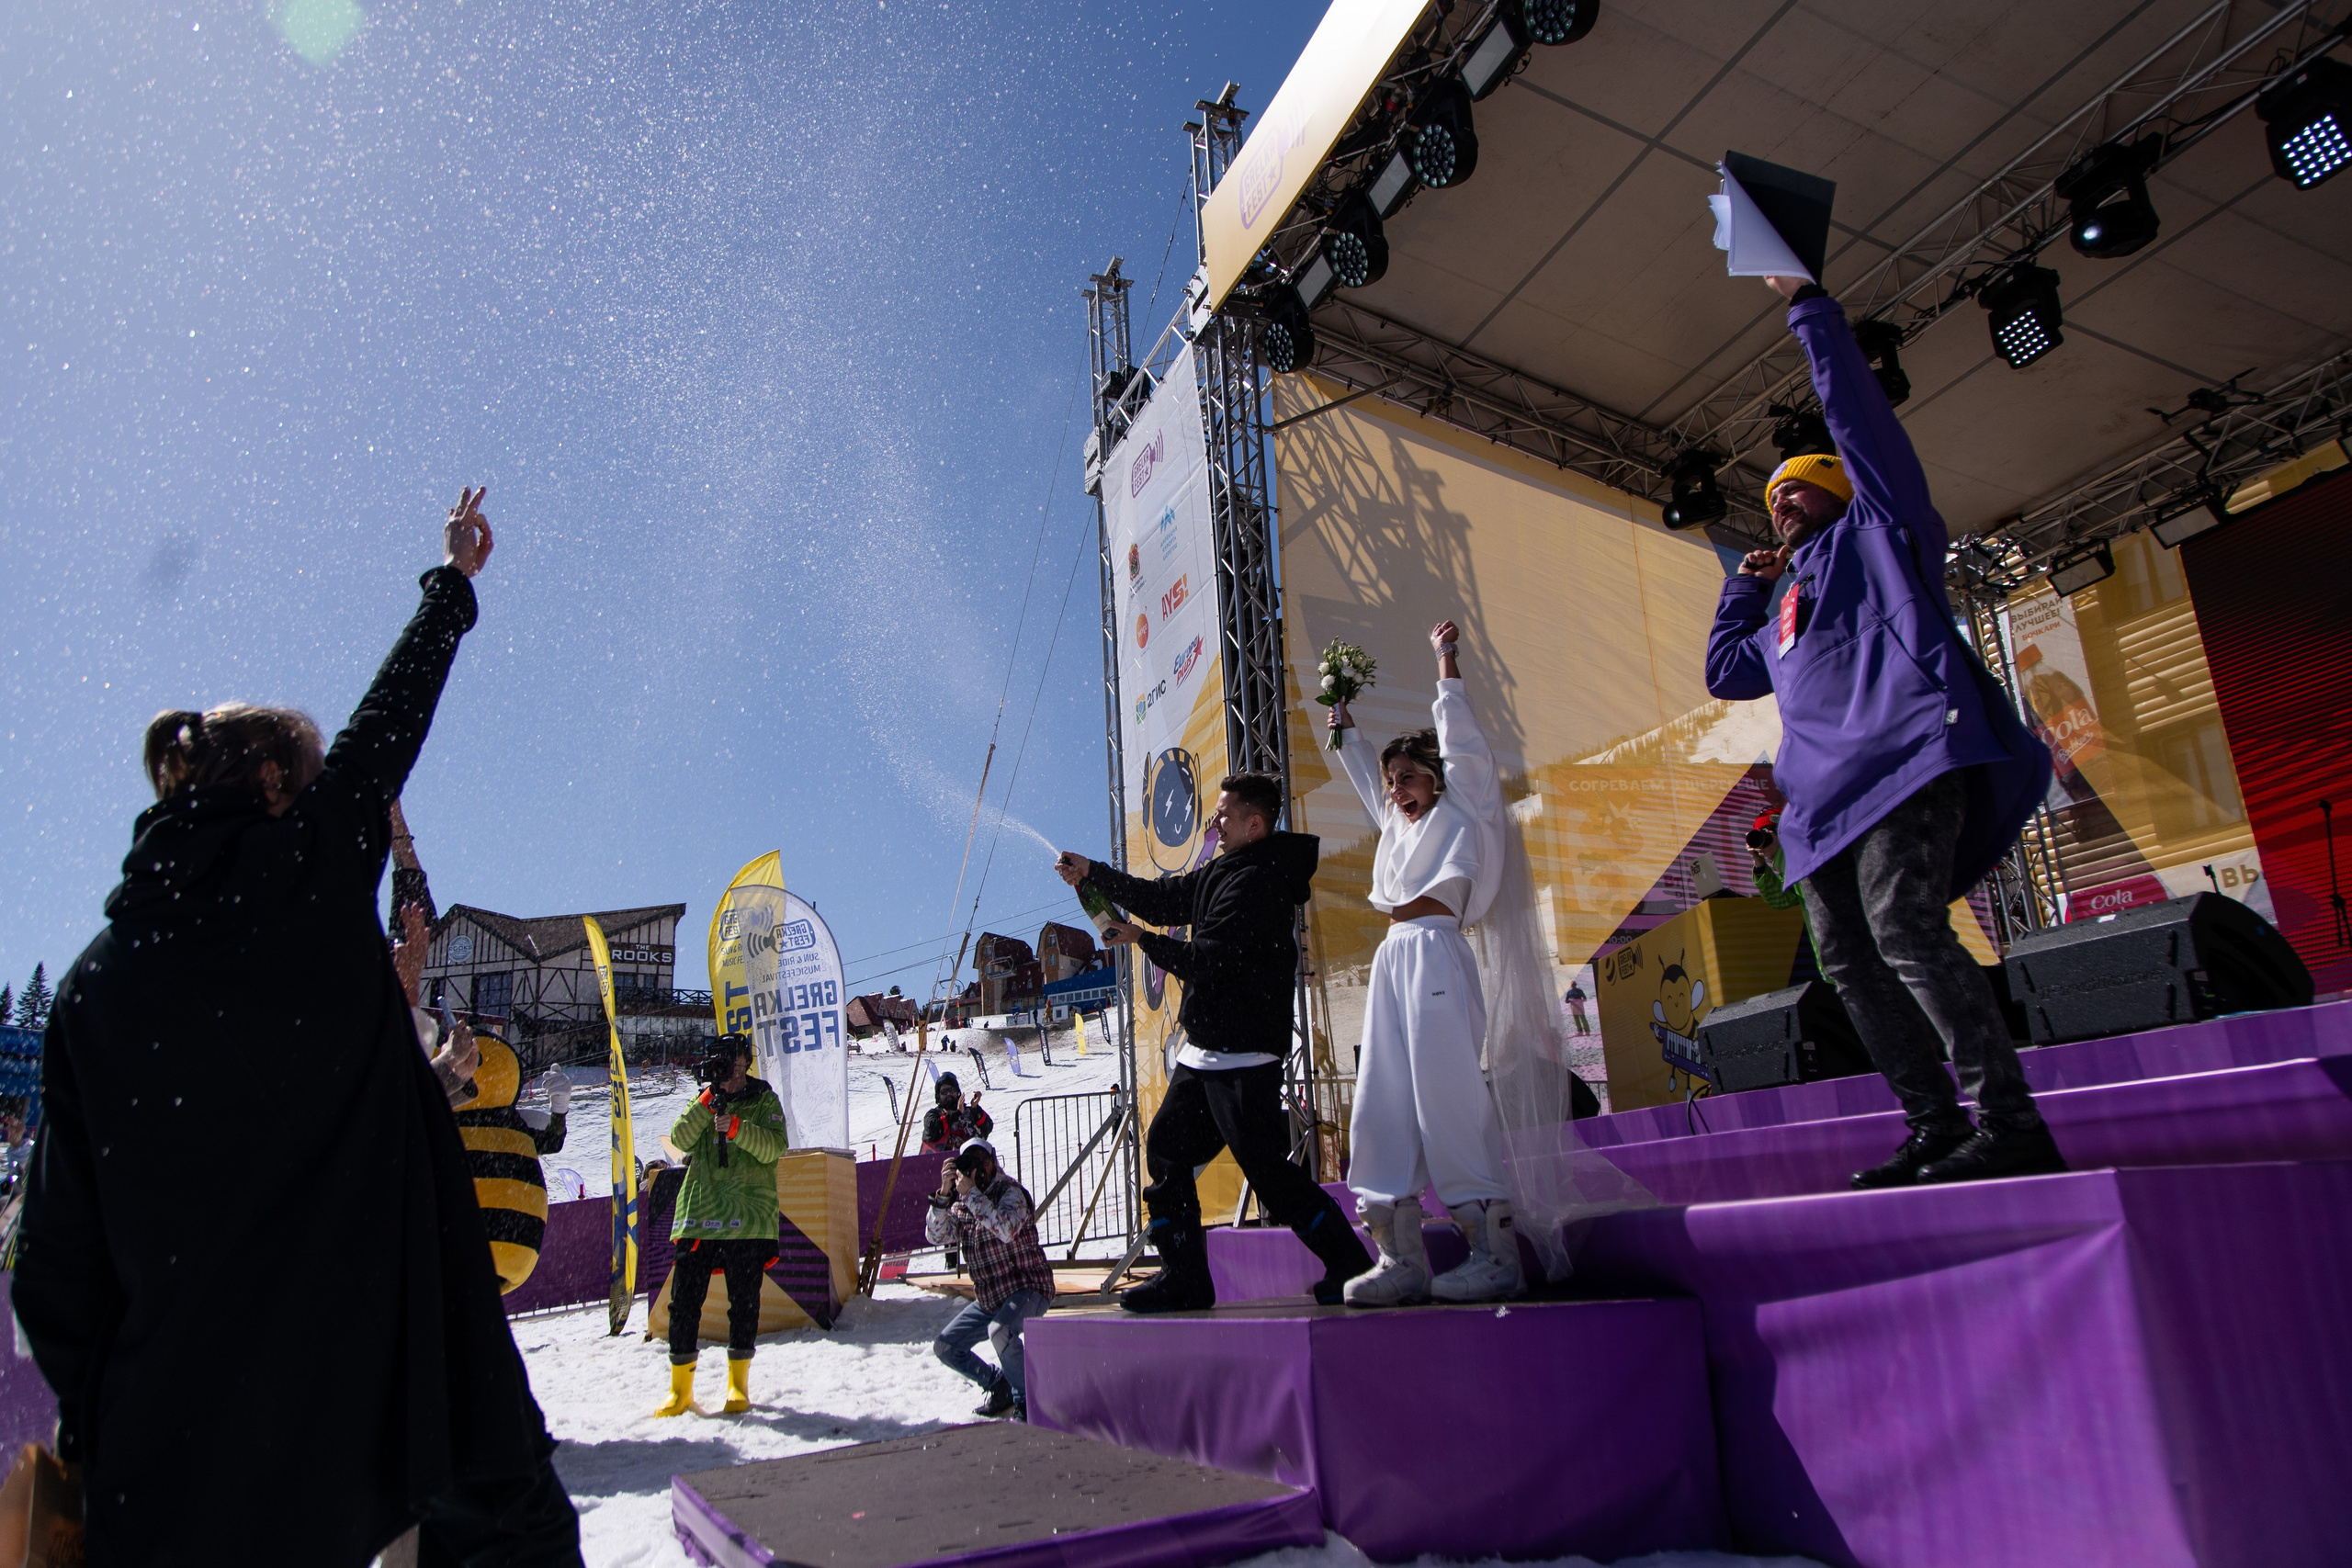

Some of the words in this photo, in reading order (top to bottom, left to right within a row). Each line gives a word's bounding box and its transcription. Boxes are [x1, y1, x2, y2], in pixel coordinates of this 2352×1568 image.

[1247, 174, 1268, 218] FEST
[1161, 572, 1190, 622] AYS!
[2010, 595, 2063, 624] ВЫБИРАЙ
[2022, 621, 2061, 641] БОЧКАРИ
[1147, 679, 1167, 708] 2ГИС
[2091, 889, 2133, 910] Cola
[724, 913, 739, 925] GRE
[724, 925, 741, 938] FES
[611, 949, 672, 963] ROOKS
